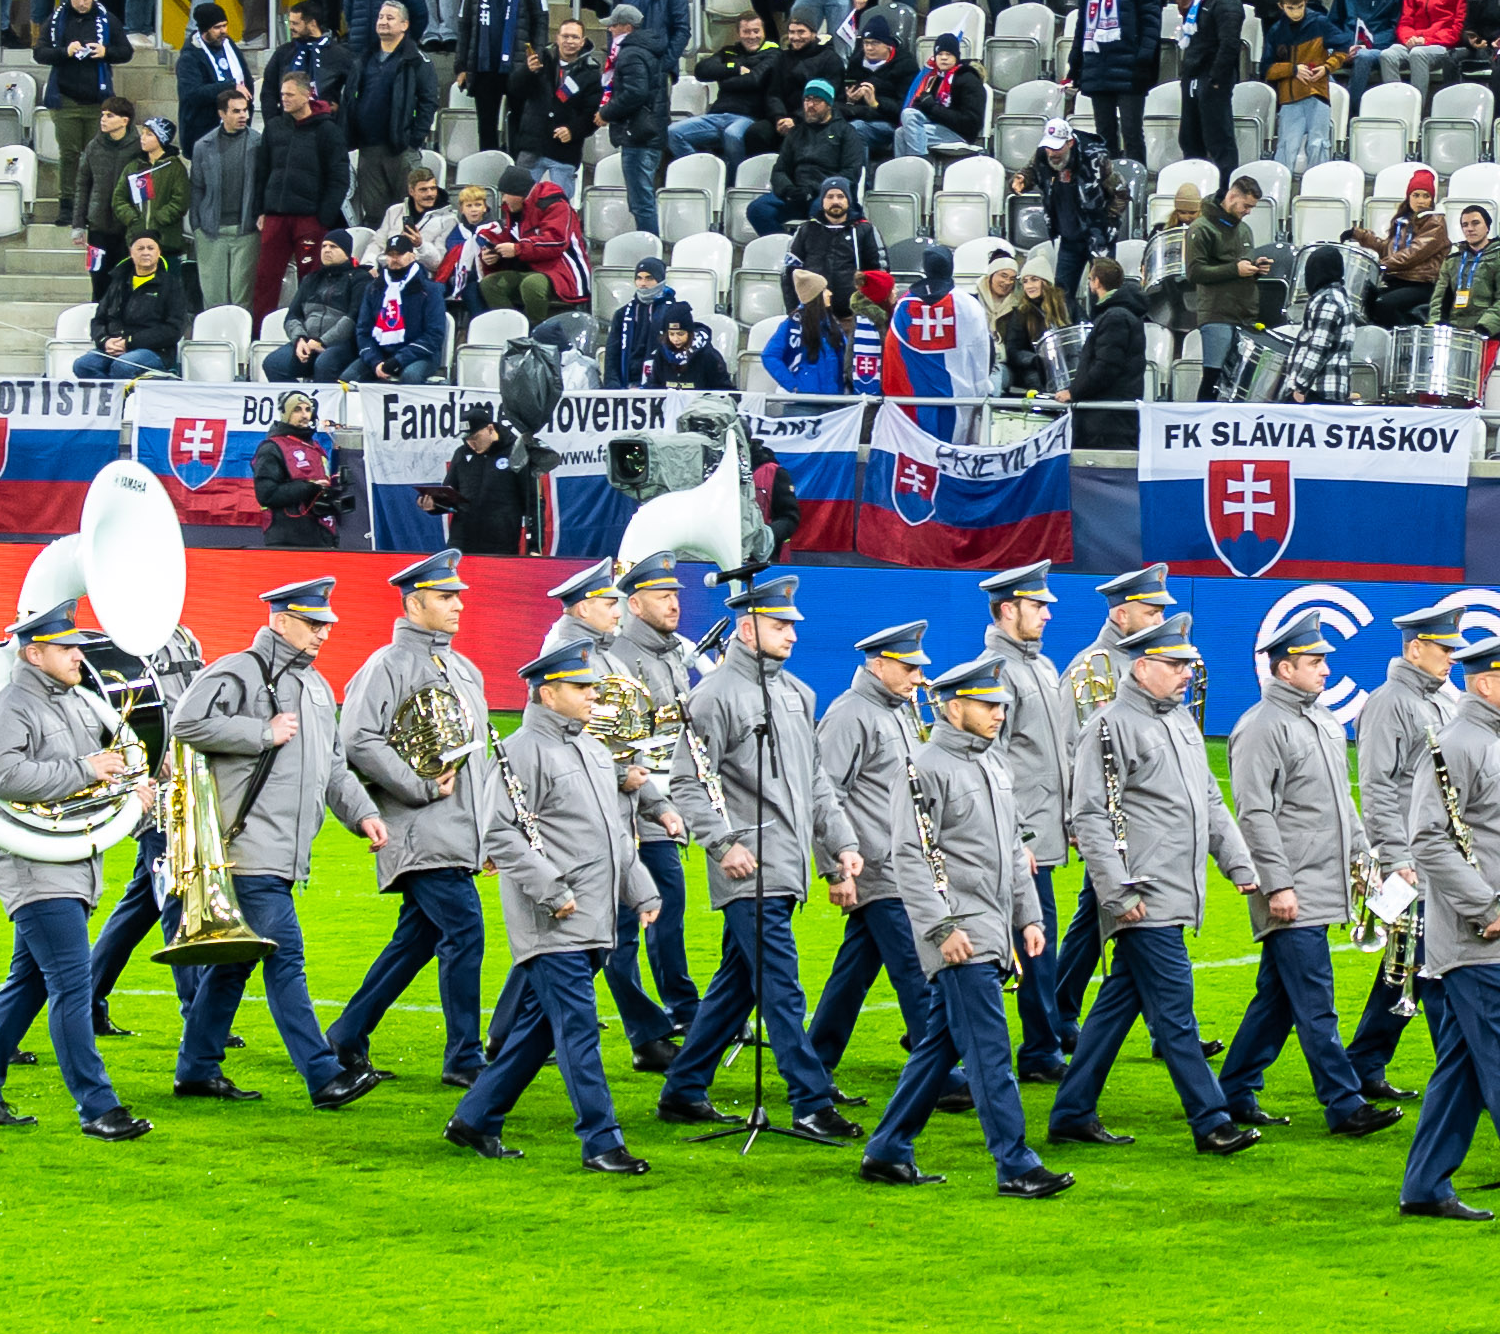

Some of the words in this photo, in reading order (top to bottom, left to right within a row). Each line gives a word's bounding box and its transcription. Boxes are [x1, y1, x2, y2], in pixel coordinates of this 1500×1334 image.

[382, 389, 504, 441] Fandím
[1164, 422, 1202, 449] FK
[1210, 414, 1317, 450] SLÁVIA
[1323, 417, 1460, 455] STAŠKOV
